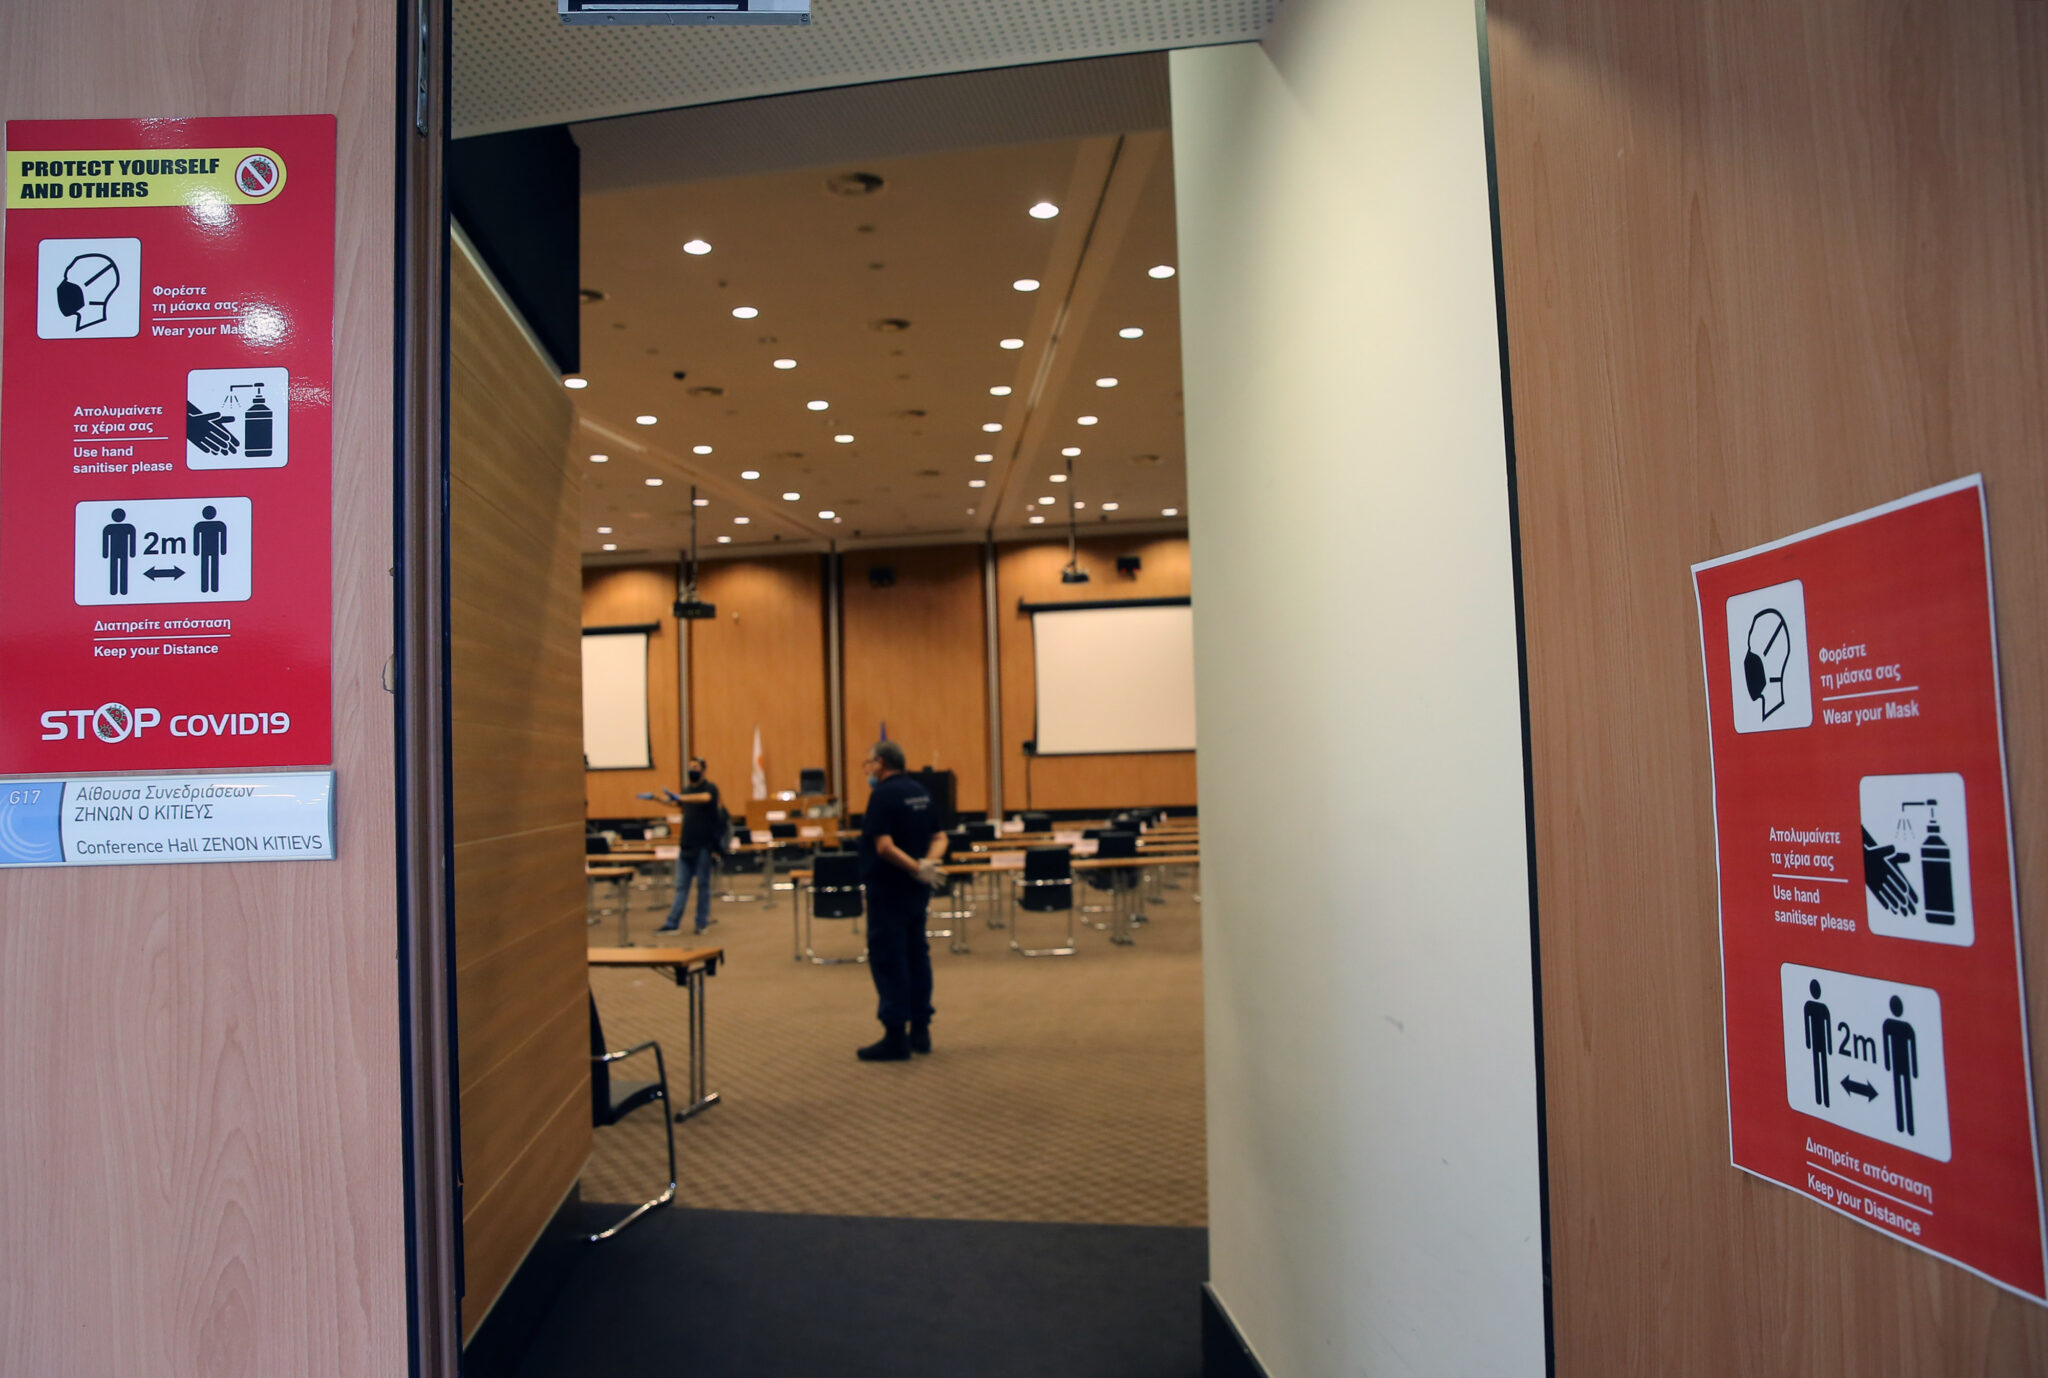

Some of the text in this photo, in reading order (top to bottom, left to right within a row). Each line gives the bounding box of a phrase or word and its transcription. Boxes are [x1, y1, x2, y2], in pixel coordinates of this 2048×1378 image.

[21, 158, 220, 177] PROTECT YOURSELF
[20, 181, 149, 199] AND OTHERS
[152, 285, 207, 298] Φορέστε
[152, 300, 238, 314] τη μάσκα σας
[152, 325, 184, 337] Wear
[188, 325, 217, 338] your
[74, 405, 163, 418] Απολυμαίνετε
[74, 420, 153, 436] τα χέρια σας
[74, 446, 134, 458] Use hand
[73, 460, 173, 475] sanitiser please
[143, 532, 187, 555] 2m
[94, 617, 231, 633] Διατηρείτε απόσταση
[94, 643, 219, 659] Keep your Distance
[1819, 643, 1867, 664] Φορέστε
[1820, 663, 1901, 689] τη μάσκα σας
[1823, 700, 1920, 726] Wear your Mask
[169, 712, 290, 737] COVID19
[9, 790, 41, 805] G17
[76, 786, 141, 801] Αίθουσα
[74, 806, 133, 822] ΖΗΝΩΝ
[155, 803, 214, 820] ΚΙΤΙΕΥΣ
[76, 835, 323, 855] Conference Hall ZENON KITIEVS
[1769, 827, 1841, 846] Απολυμαίνετε
[1770, 850, 1834, 871] τα χέρια σας
[1773, 885, 1820, 904] Use hand
[1774, 909, 1856, 932] sanitiser please
[1837, 1021, 1877, 1064] 2m
[1806, 1136, 1933, 1204] Διατηρείτε απόσταση
[1807, 1172, 1921, 1236] Keep your Distance
